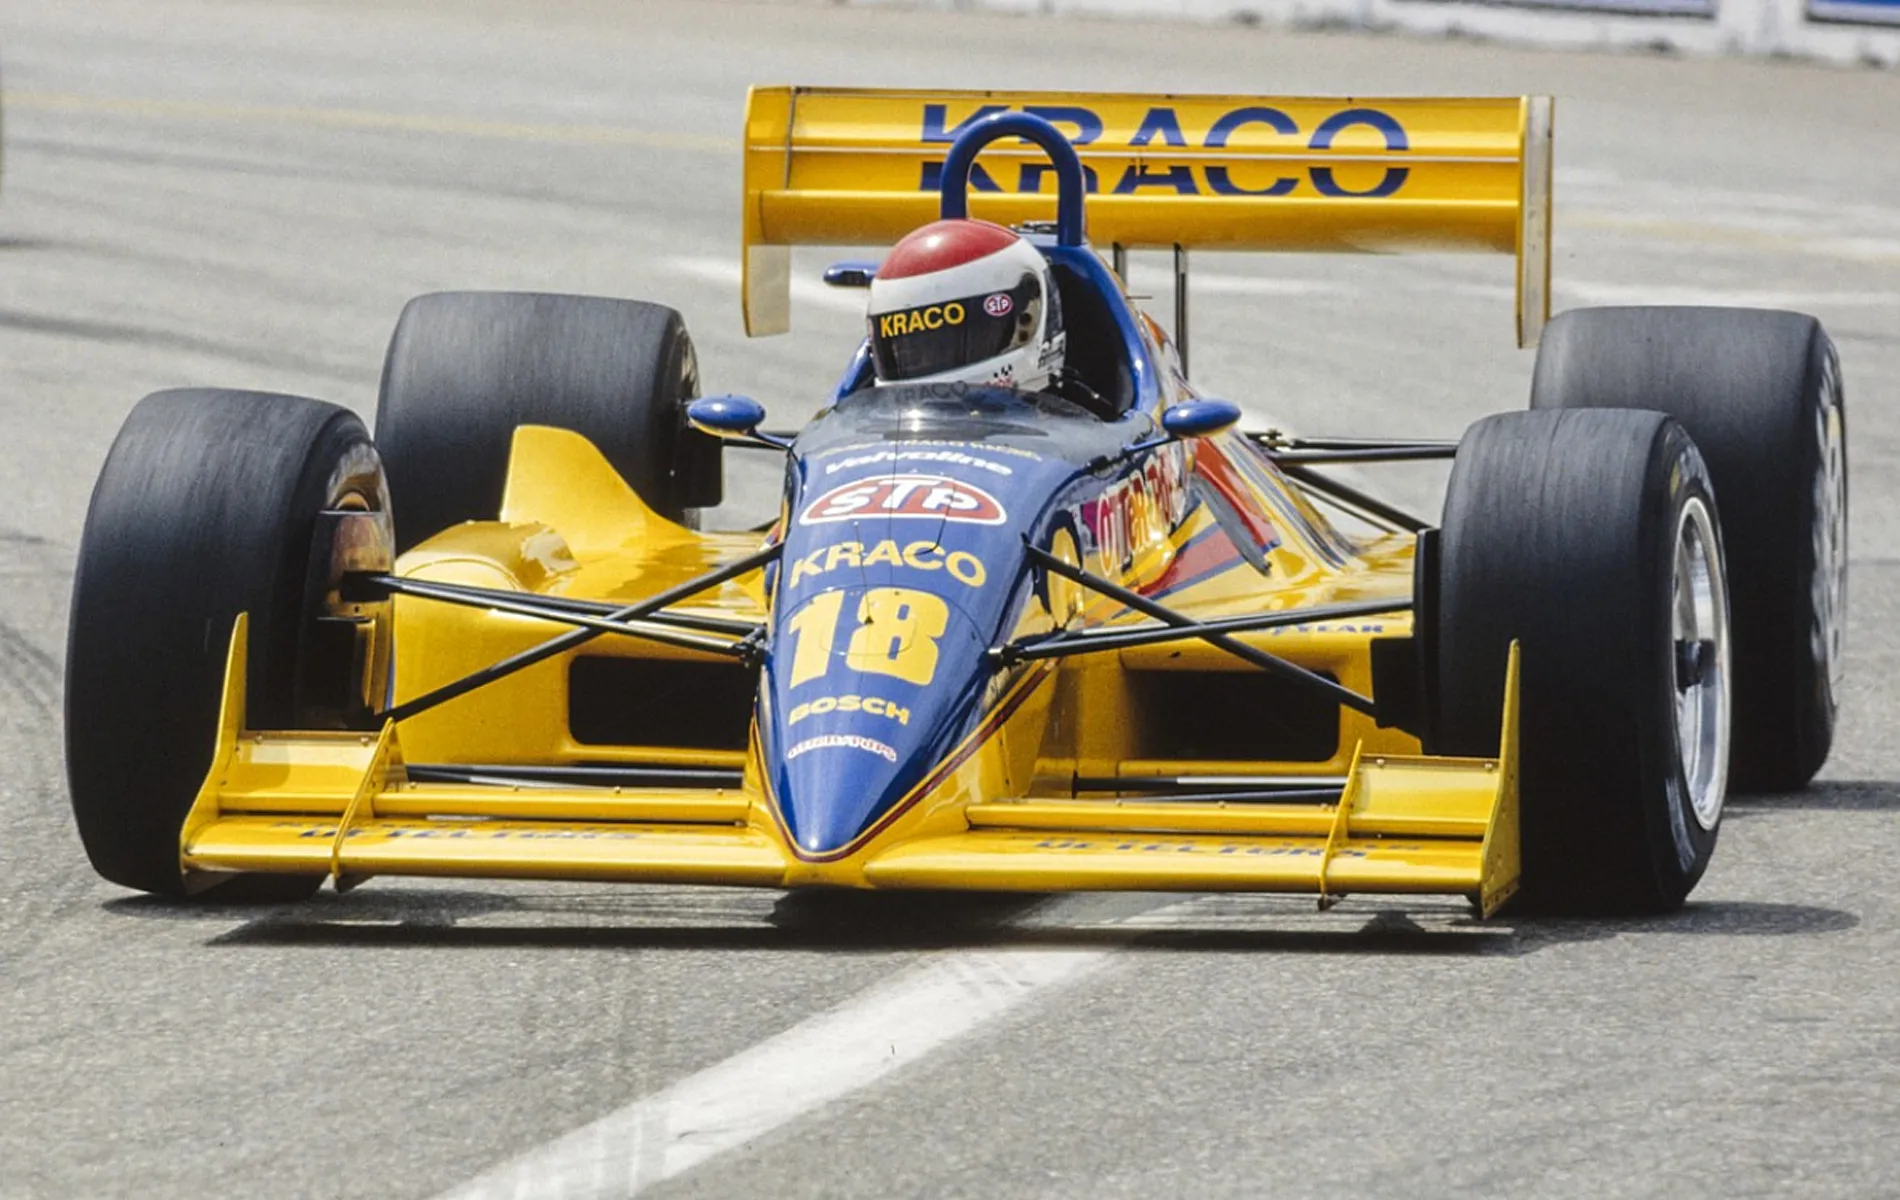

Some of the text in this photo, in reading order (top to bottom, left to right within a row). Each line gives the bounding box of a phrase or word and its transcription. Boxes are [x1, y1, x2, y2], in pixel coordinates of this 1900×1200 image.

[918, 103, 1410, 199] KRACO
[880, 303, 965, 338] KRACO
[822, 478, 982, 516] STP
[789, 539, 987, 590] KRACO
[788, 587, 949, 690] 18
[788, 695, 911, 726] BOSCH
